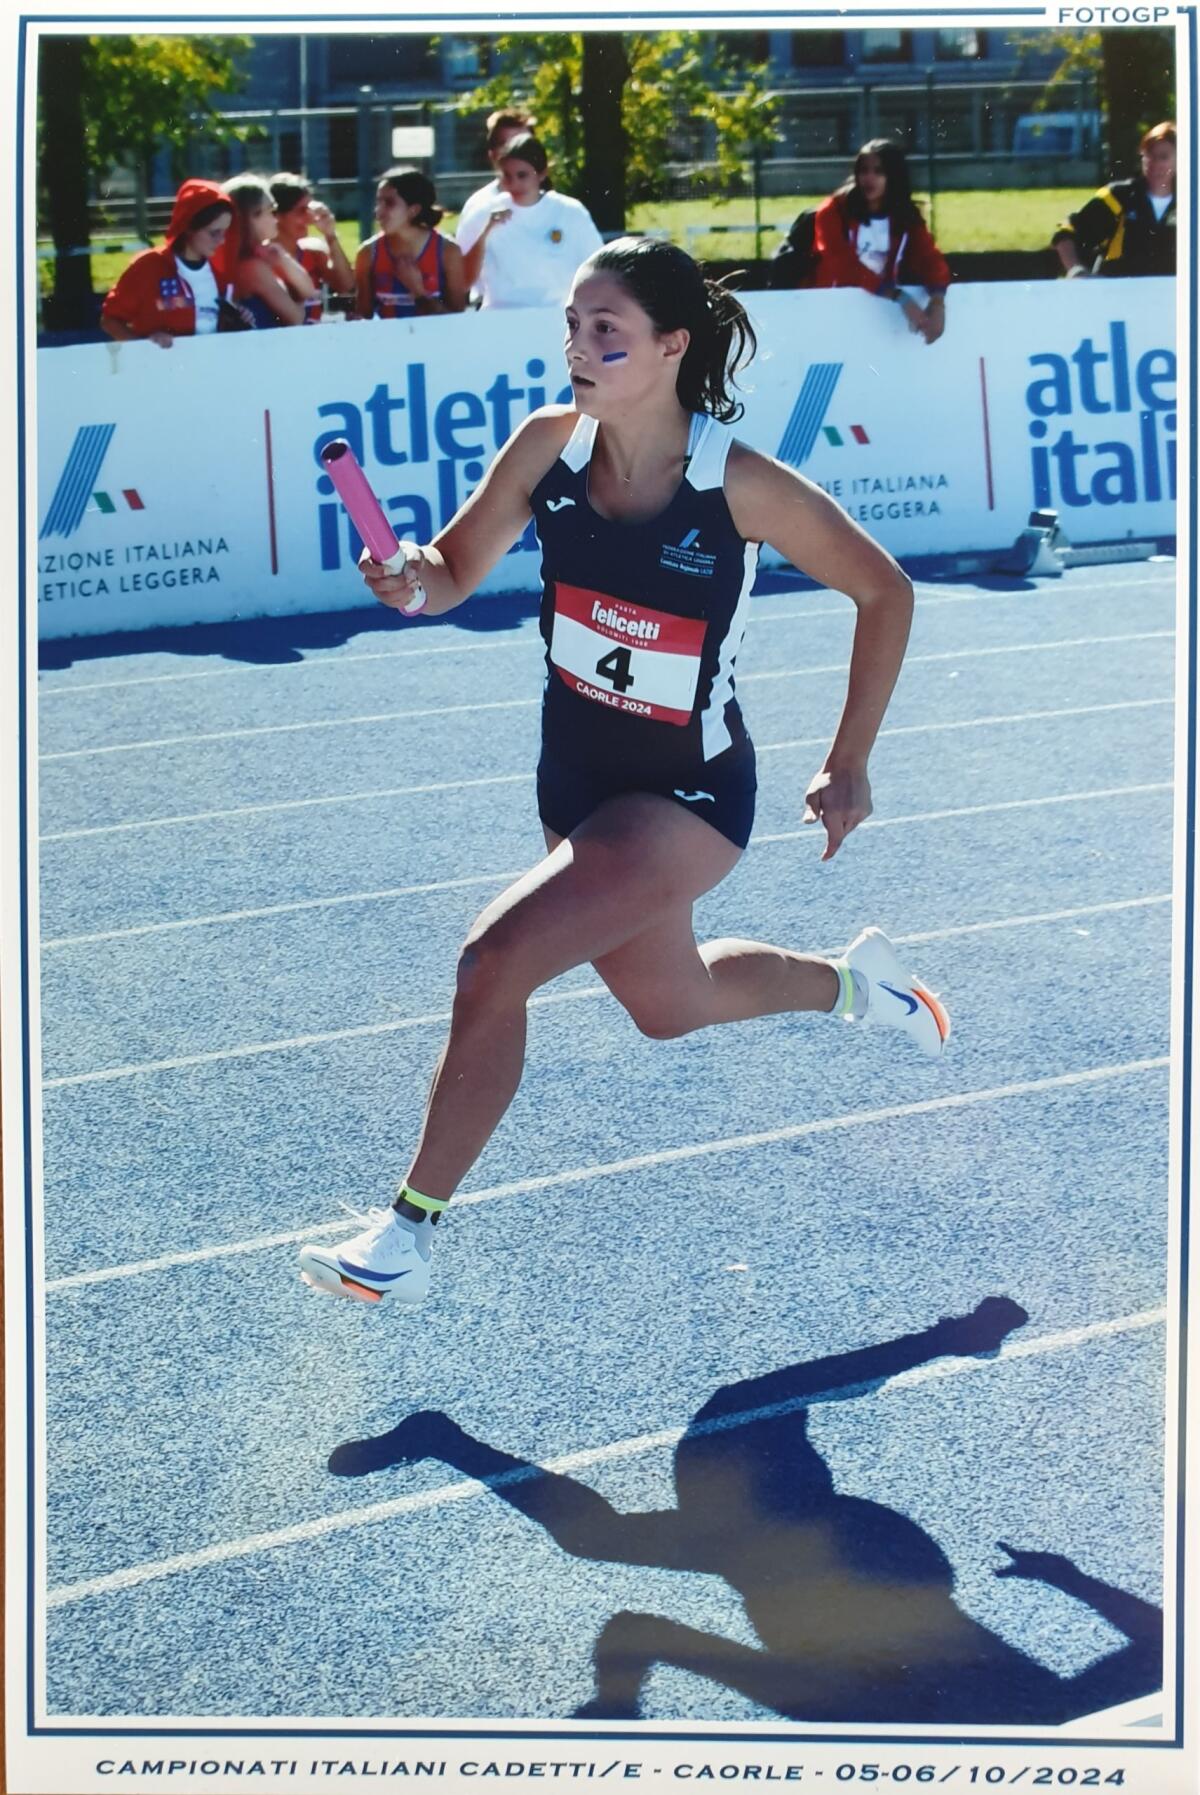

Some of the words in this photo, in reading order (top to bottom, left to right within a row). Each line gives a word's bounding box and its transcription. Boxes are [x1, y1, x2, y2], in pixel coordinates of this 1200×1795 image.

[313, 358, 576, 469] atleti
[852, 473, 949, 495] ITALIANA
[125, 537, 230, 563] ITALIANA
[38, 578, 110, 602] ETICA
[119, 565, 220, 593] LEGGERA
[591, 600, 660, 640] felicetti
[595, 646, 635, 694] 4
[576, 682, 620, 707] CAORLE
[621, 700, 652, 715] 2024
